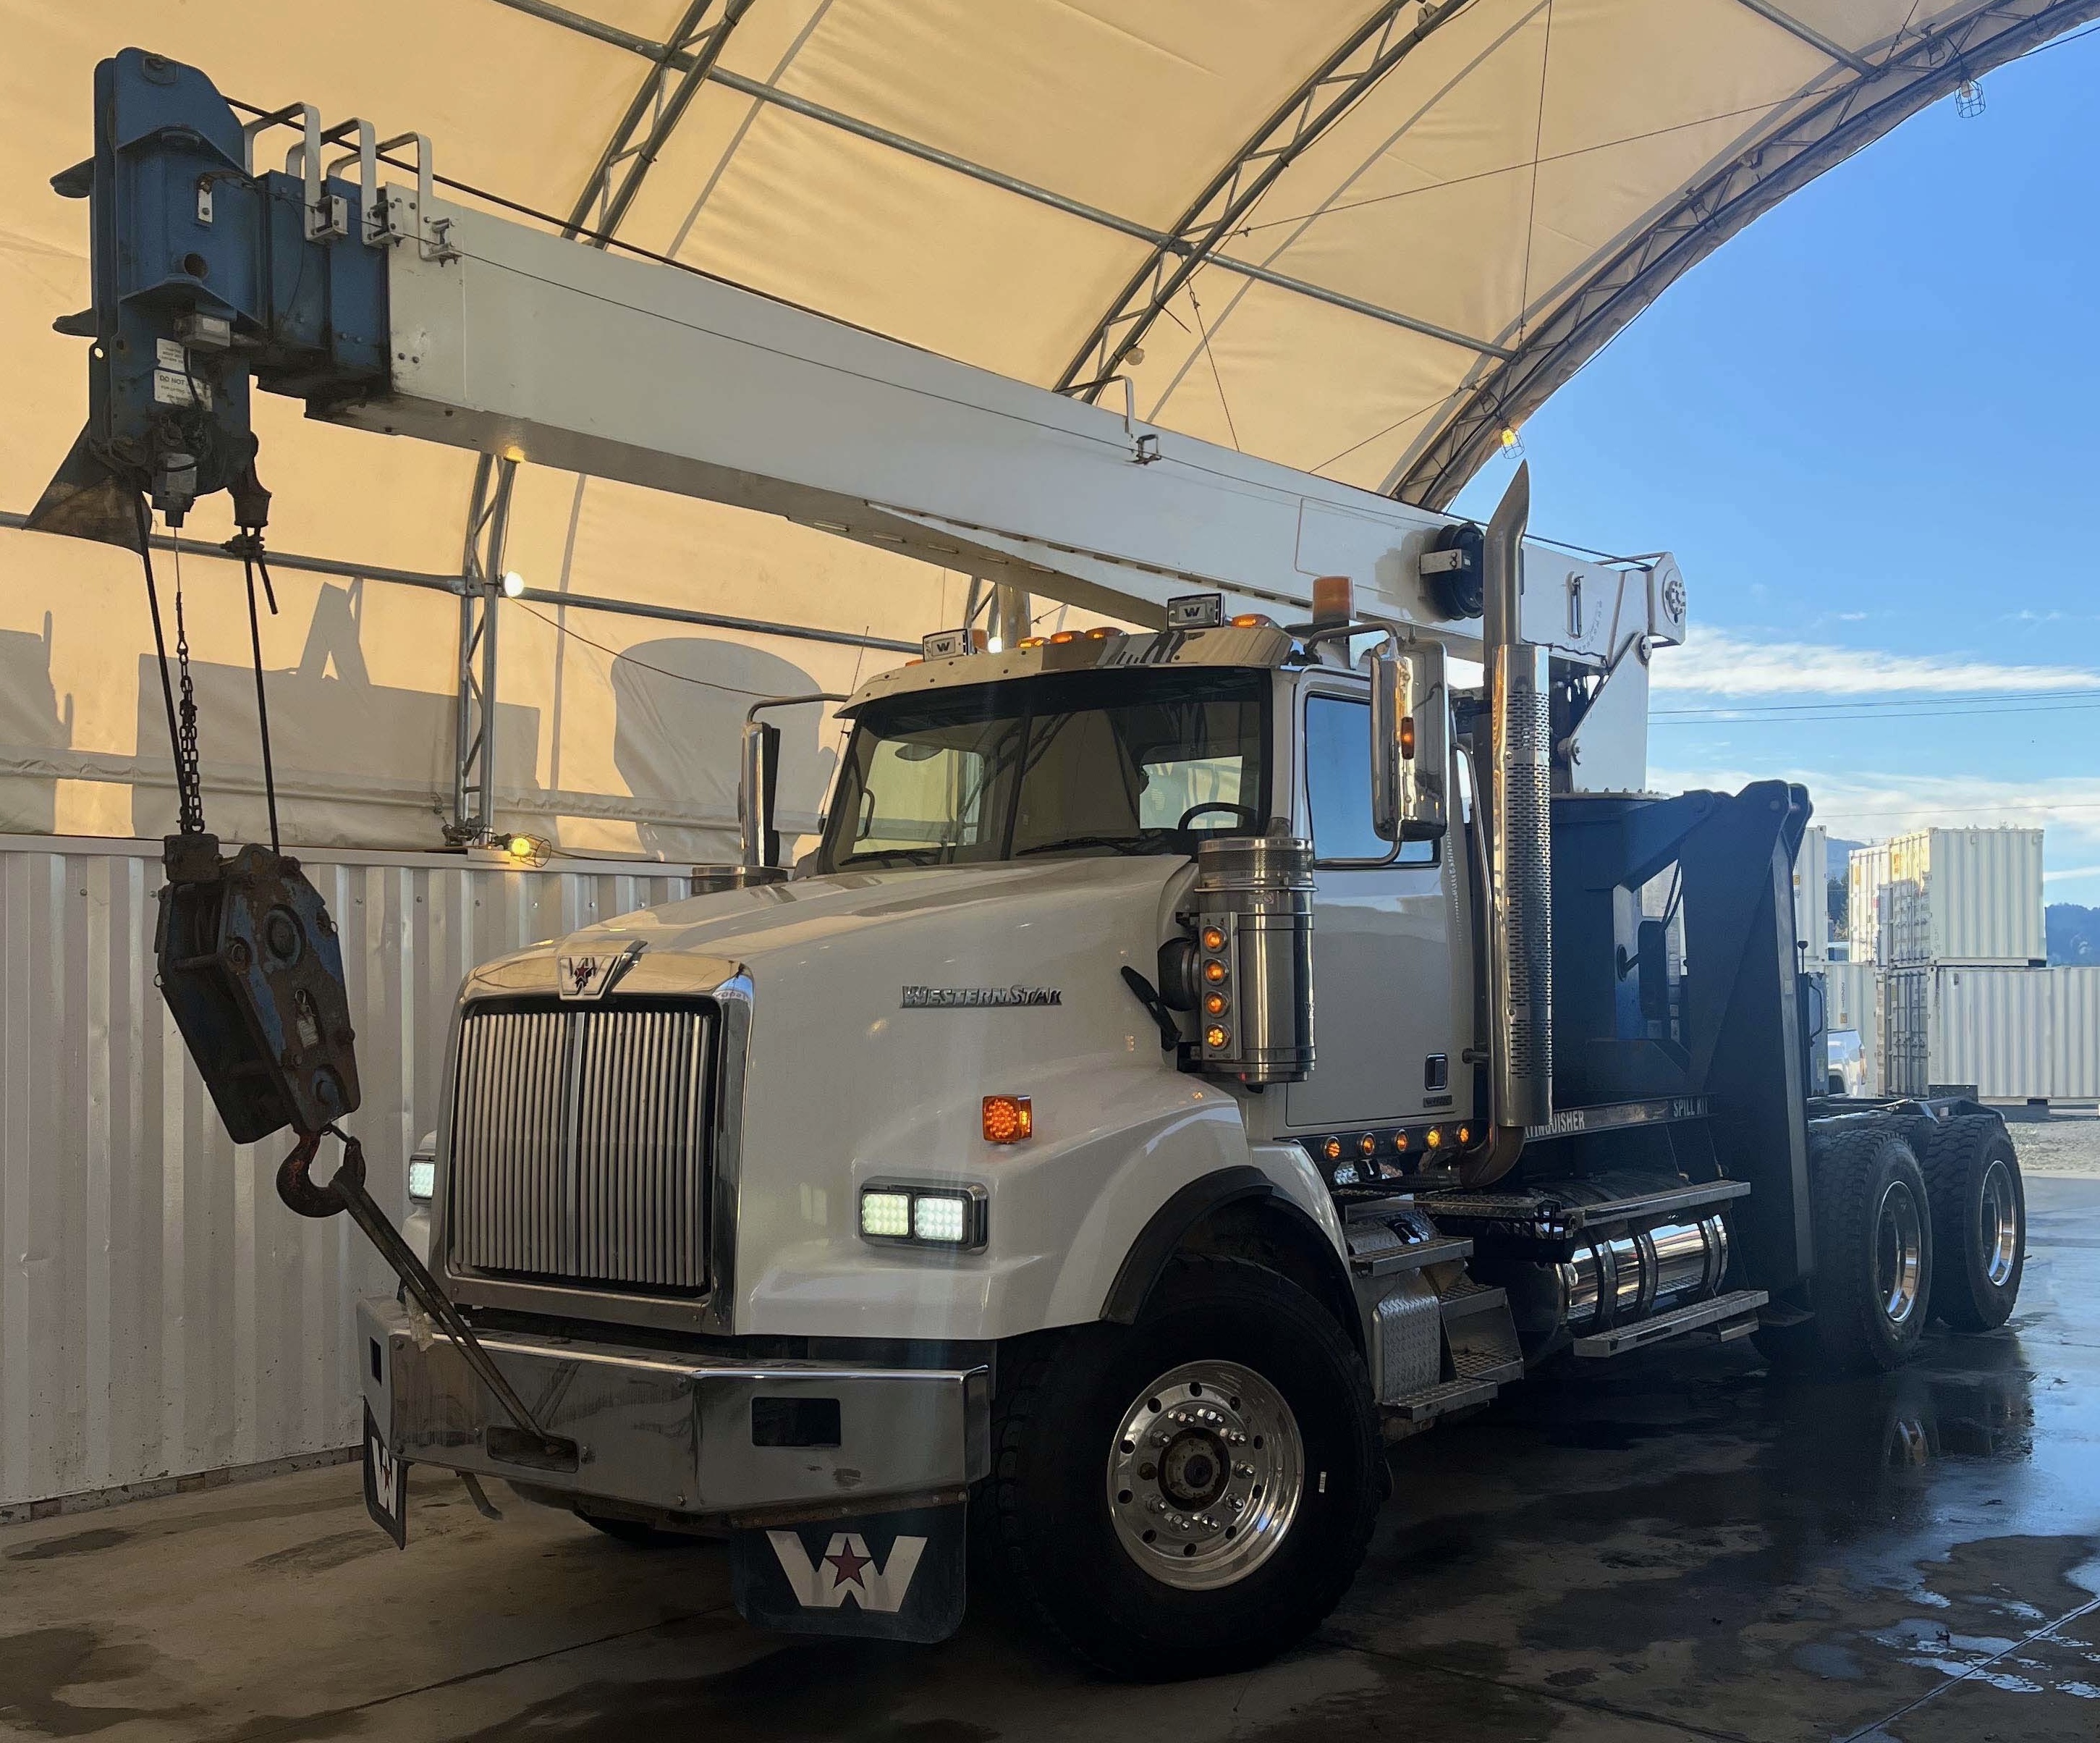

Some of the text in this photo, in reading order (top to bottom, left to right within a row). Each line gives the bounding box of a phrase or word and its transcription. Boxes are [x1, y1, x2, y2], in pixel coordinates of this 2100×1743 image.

[902, 984, 1062, 1007] WESTERN STAR
[1673, 1097, 1695, 1118] SPILL
